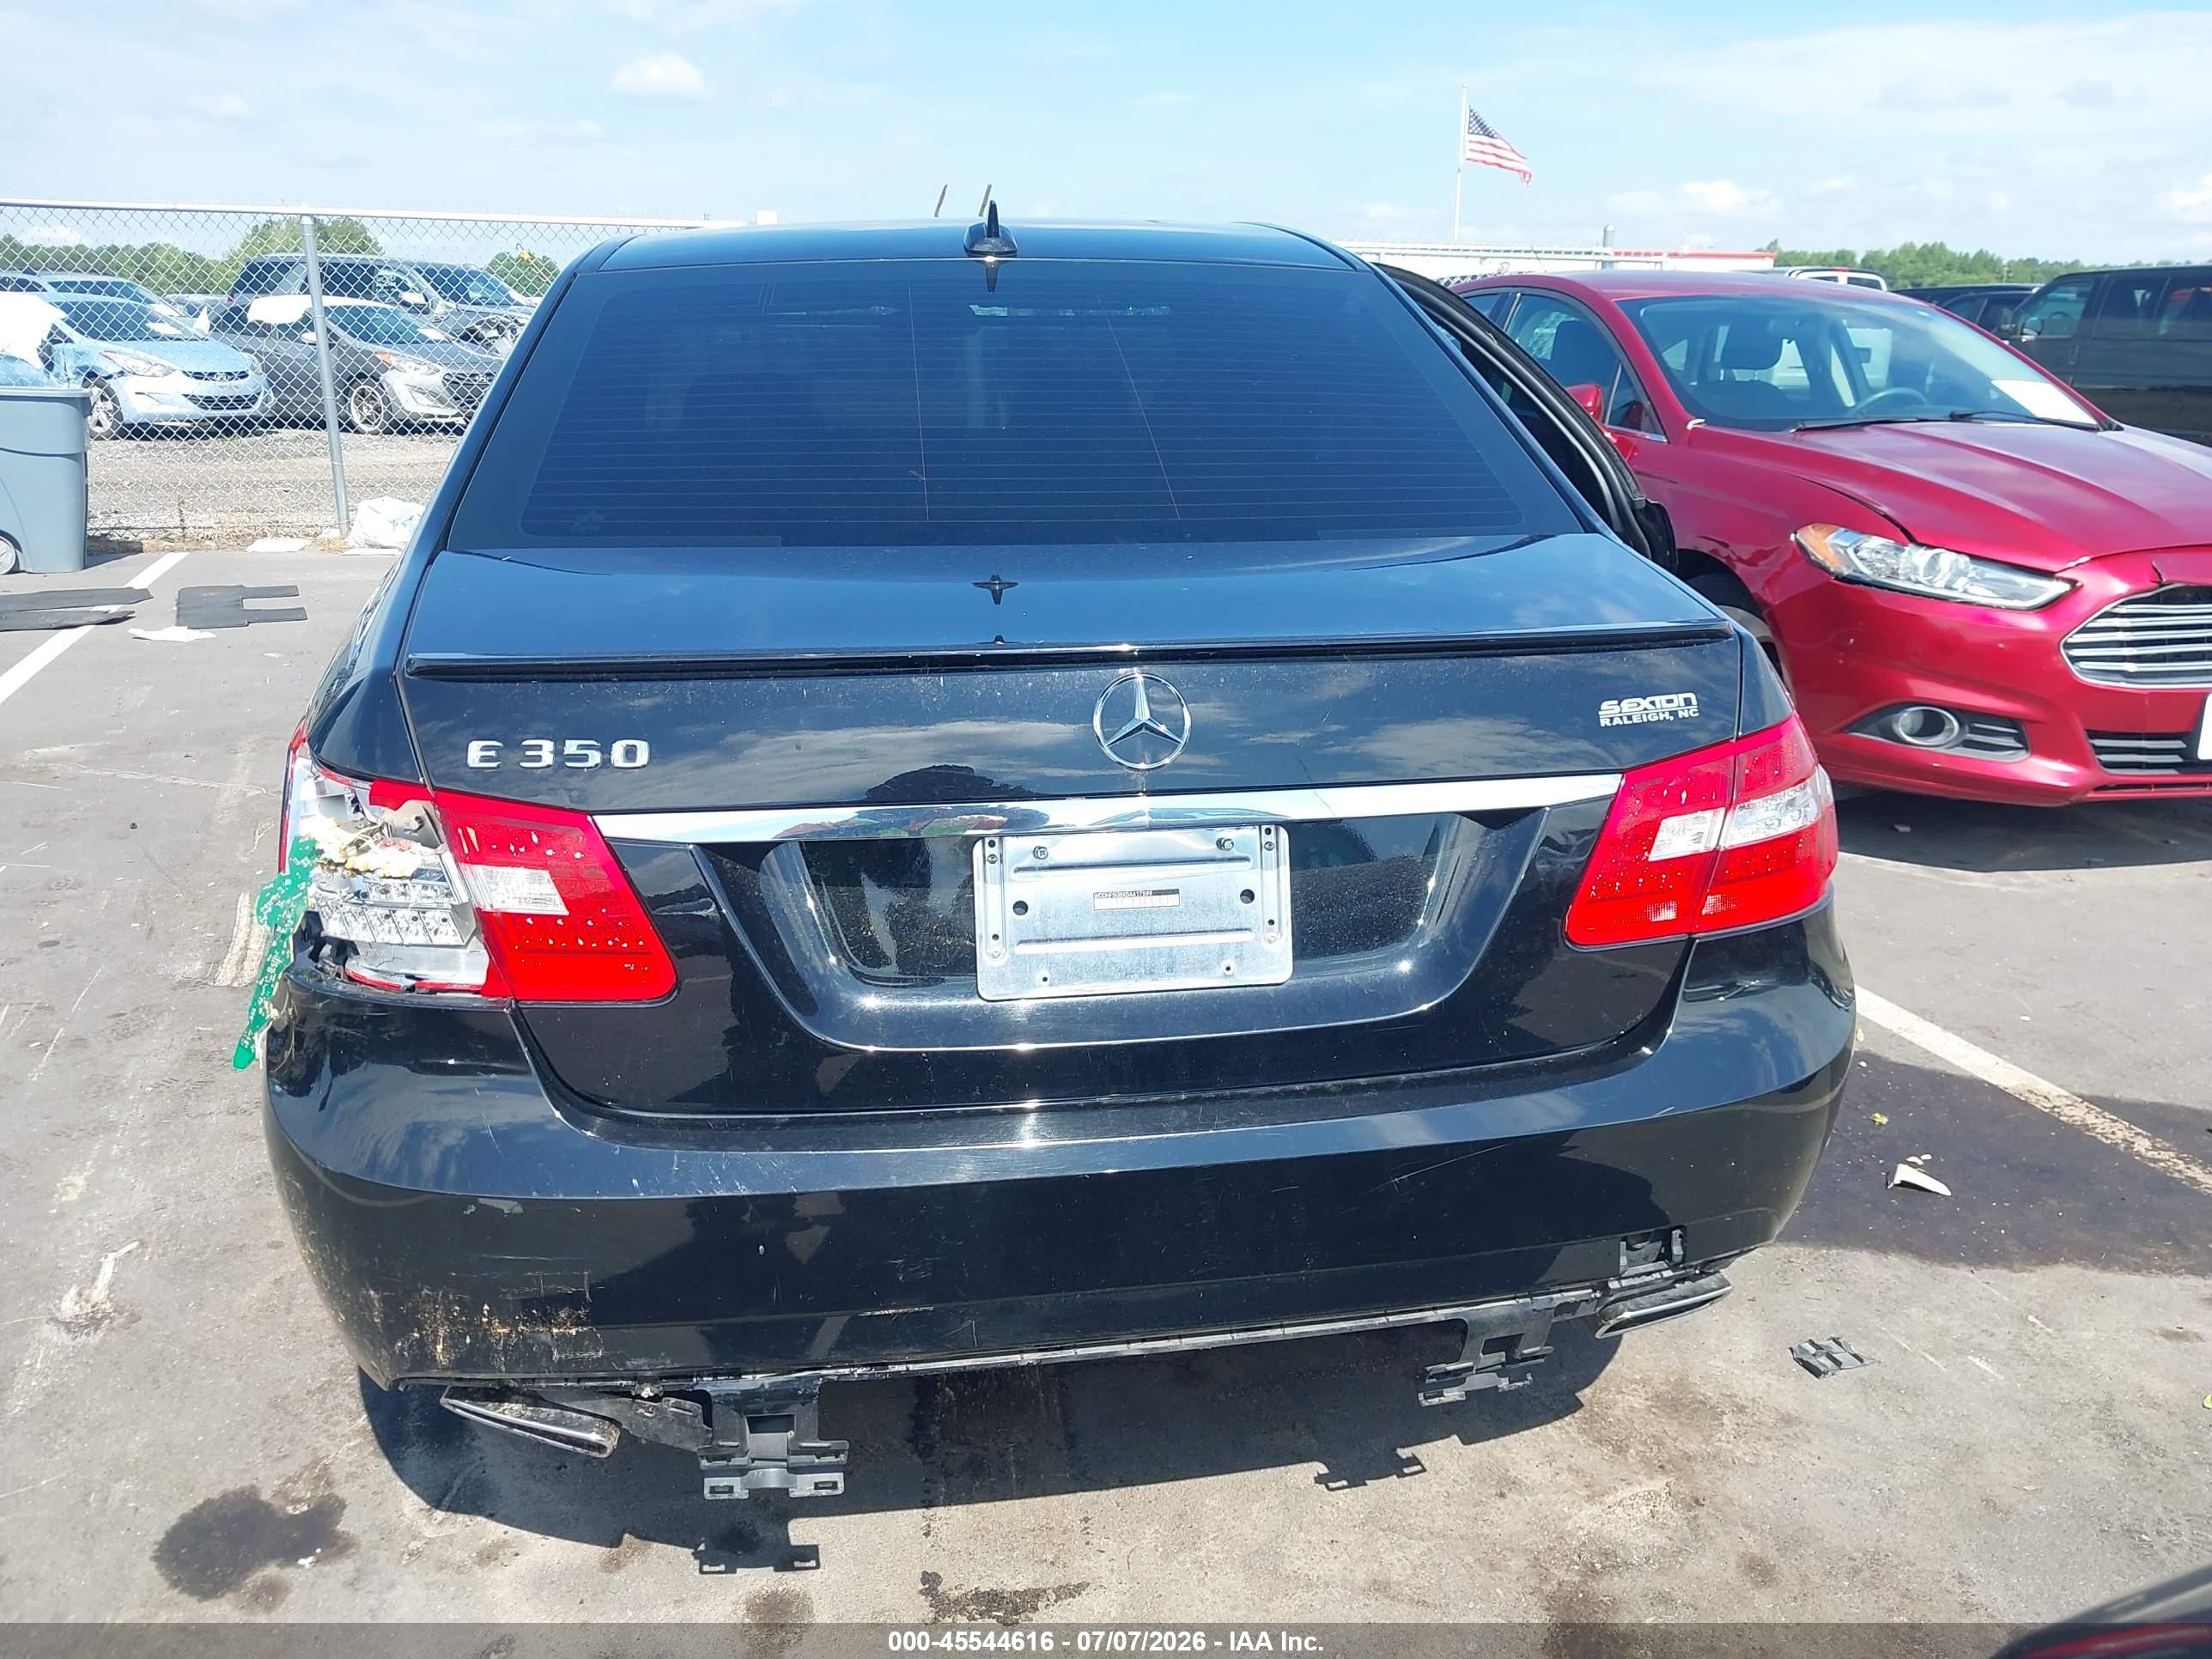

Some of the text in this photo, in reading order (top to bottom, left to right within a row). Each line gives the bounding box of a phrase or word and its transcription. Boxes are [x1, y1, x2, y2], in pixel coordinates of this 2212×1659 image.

[1600, 708, 1699, 727] RALEIGH, NC
[466, 739, 651, 769] E 350
